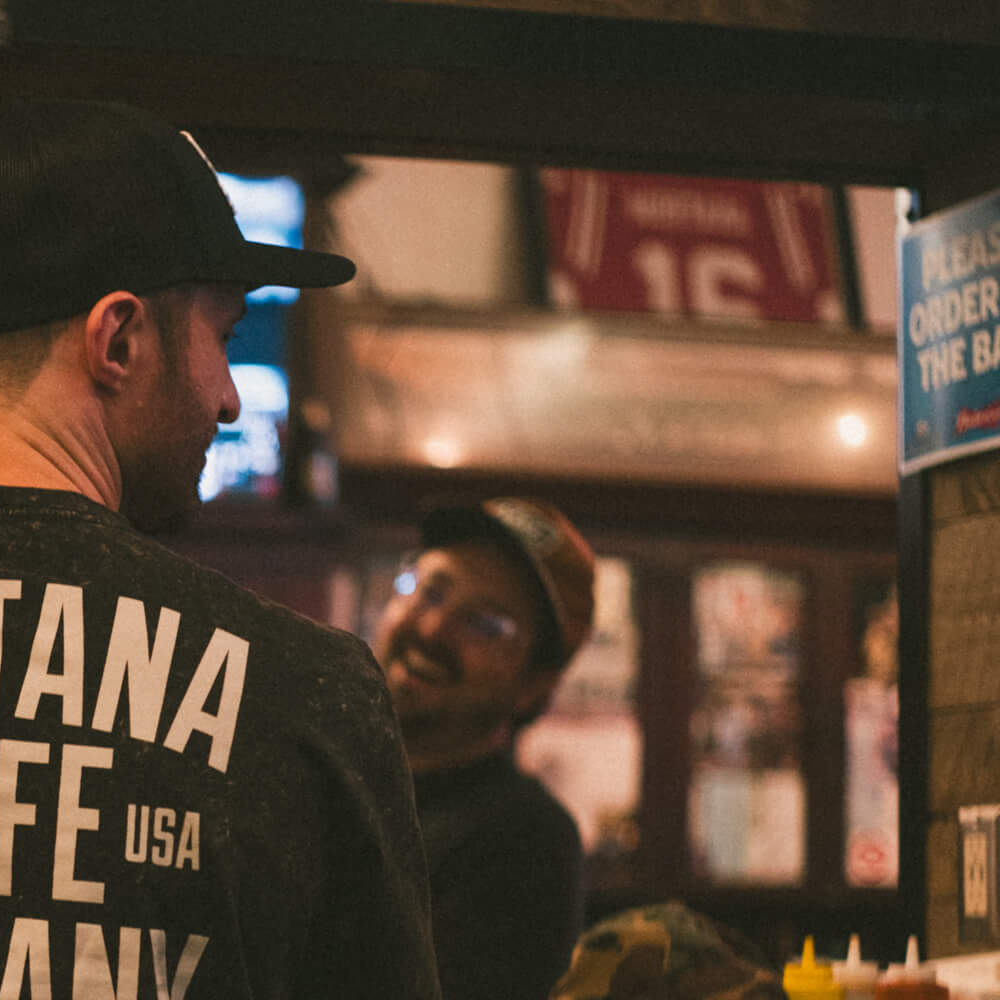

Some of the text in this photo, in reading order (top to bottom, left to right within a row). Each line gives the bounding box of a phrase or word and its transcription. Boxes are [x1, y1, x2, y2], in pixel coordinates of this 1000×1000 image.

[908, 275, 999, 347] ORDER
[916, 335, 968, 393] THE
[124, 803, 201, 871] USA
